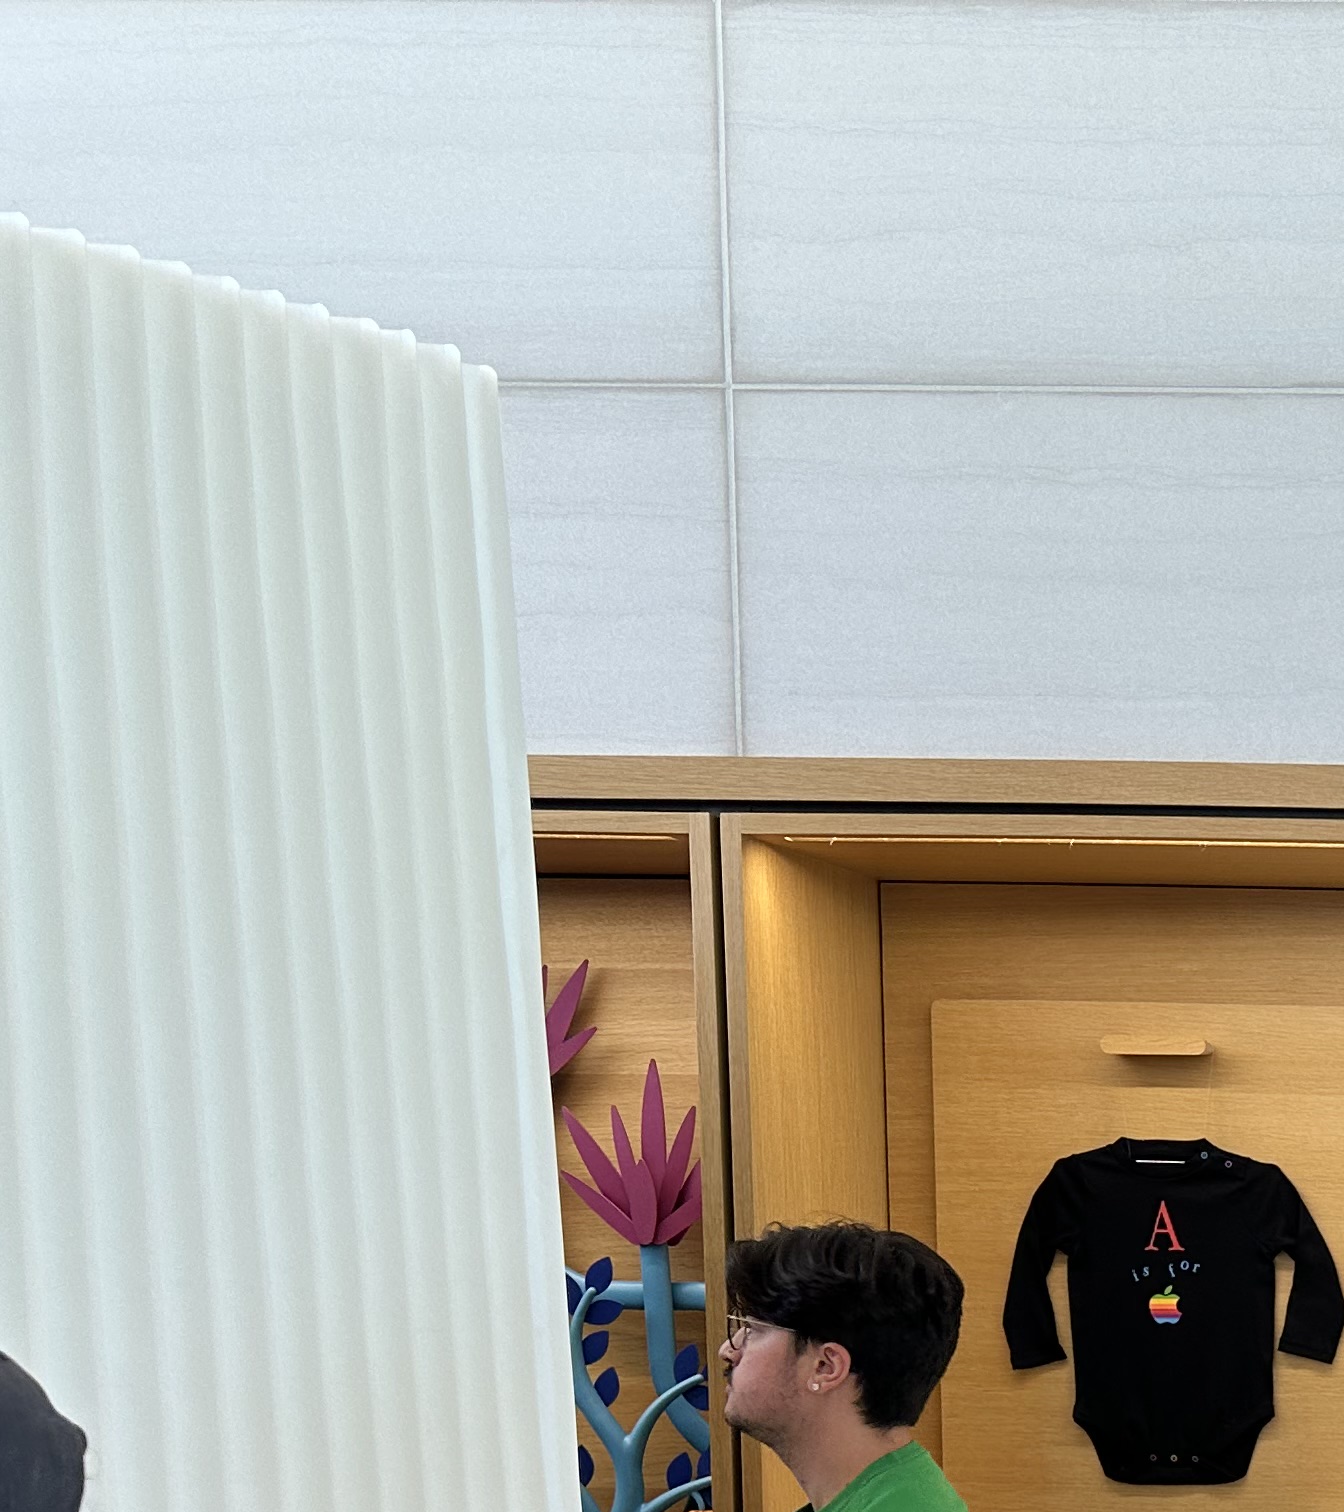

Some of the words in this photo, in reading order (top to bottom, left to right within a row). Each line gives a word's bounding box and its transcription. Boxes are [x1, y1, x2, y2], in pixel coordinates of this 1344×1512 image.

[1144, 1200, 1185, 1251] A
[1131, 1267, 1150, 1282] is
[1168, 1260, 1200, 1278] for
